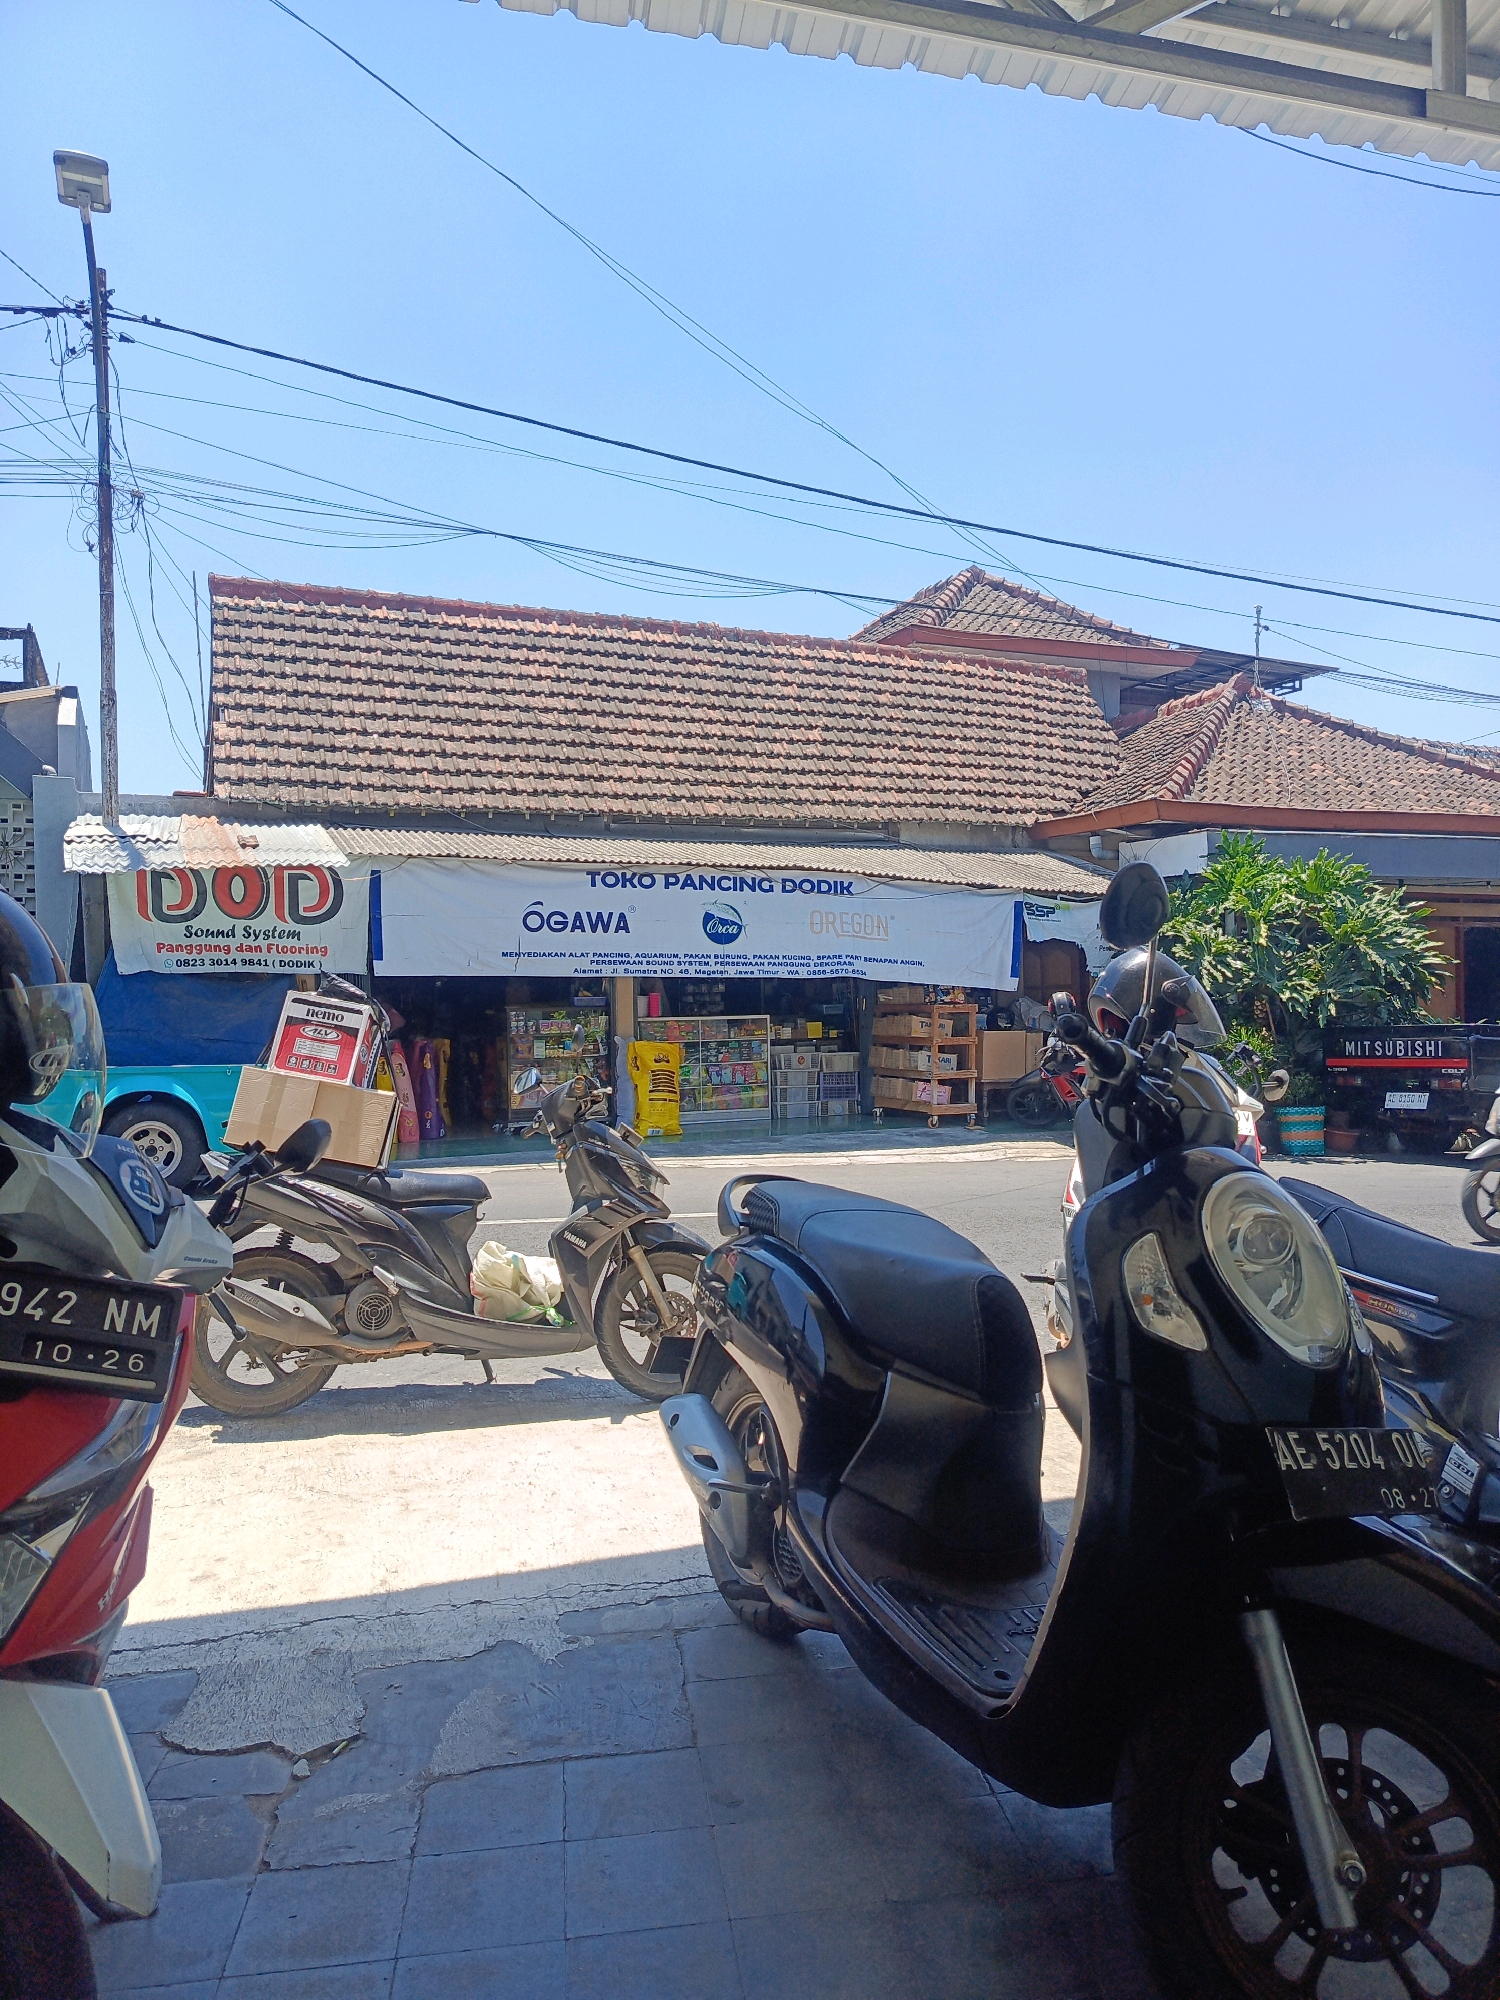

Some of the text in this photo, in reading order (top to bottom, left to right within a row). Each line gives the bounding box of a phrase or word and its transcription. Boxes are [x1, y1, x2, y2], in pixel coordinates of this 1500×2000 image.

[586, 871, 854, 896] TOKO PANCING DODIK
[522, 903, 631, 933] OGAWA
[1024, 902, 1055, 917] SSP
[184, 924, 301, 941] Sound System
[707, 918, 739, 934] Orca
[810, 910, 888, 940] OREGON
[156, 942, 329, 957] Panggung dan Flooring
[501, 951, 566, 959] MENYEDIAKAN
[592, 952, 632, 960] PANCING,
[634, 952, 682, 960] AQUARIUM,
[714, 953, 751, 961] BURUNG,
[782, 954, 814, 962] KUCING,
[863, 956, 898, 965] SENAPAN
[176, 958, 206, 968] 0823
[208, 958, 237, 967] 3014
[240, 958, 269, 968] 9841
[279, 959, 315, 968] DODIK
[590, 959, 644, 967] PERSEWAAN
[645, 959, 675, 967] SOUND
[676, 960, 712, 968] SYSTEM,
[714, 960, 765, 968] PERSEWAAN
[813, 960, 855, 968] DEKORASI
[694, 968, 732, 977] Magetan,
[306, 1008, 344, 1022] nemo
[1345, 1040, 1443, 1057] MITSUBISHI
[563, 1231, 588, 1249] YAMAHA
[0, 1282, 161, 1338] 942 NM
[1368, 1297, 1418, 1321] HONDA
[1274, 1431, 1315, 1470] AE
[1316, 1431, 1385, 1470] 5204
